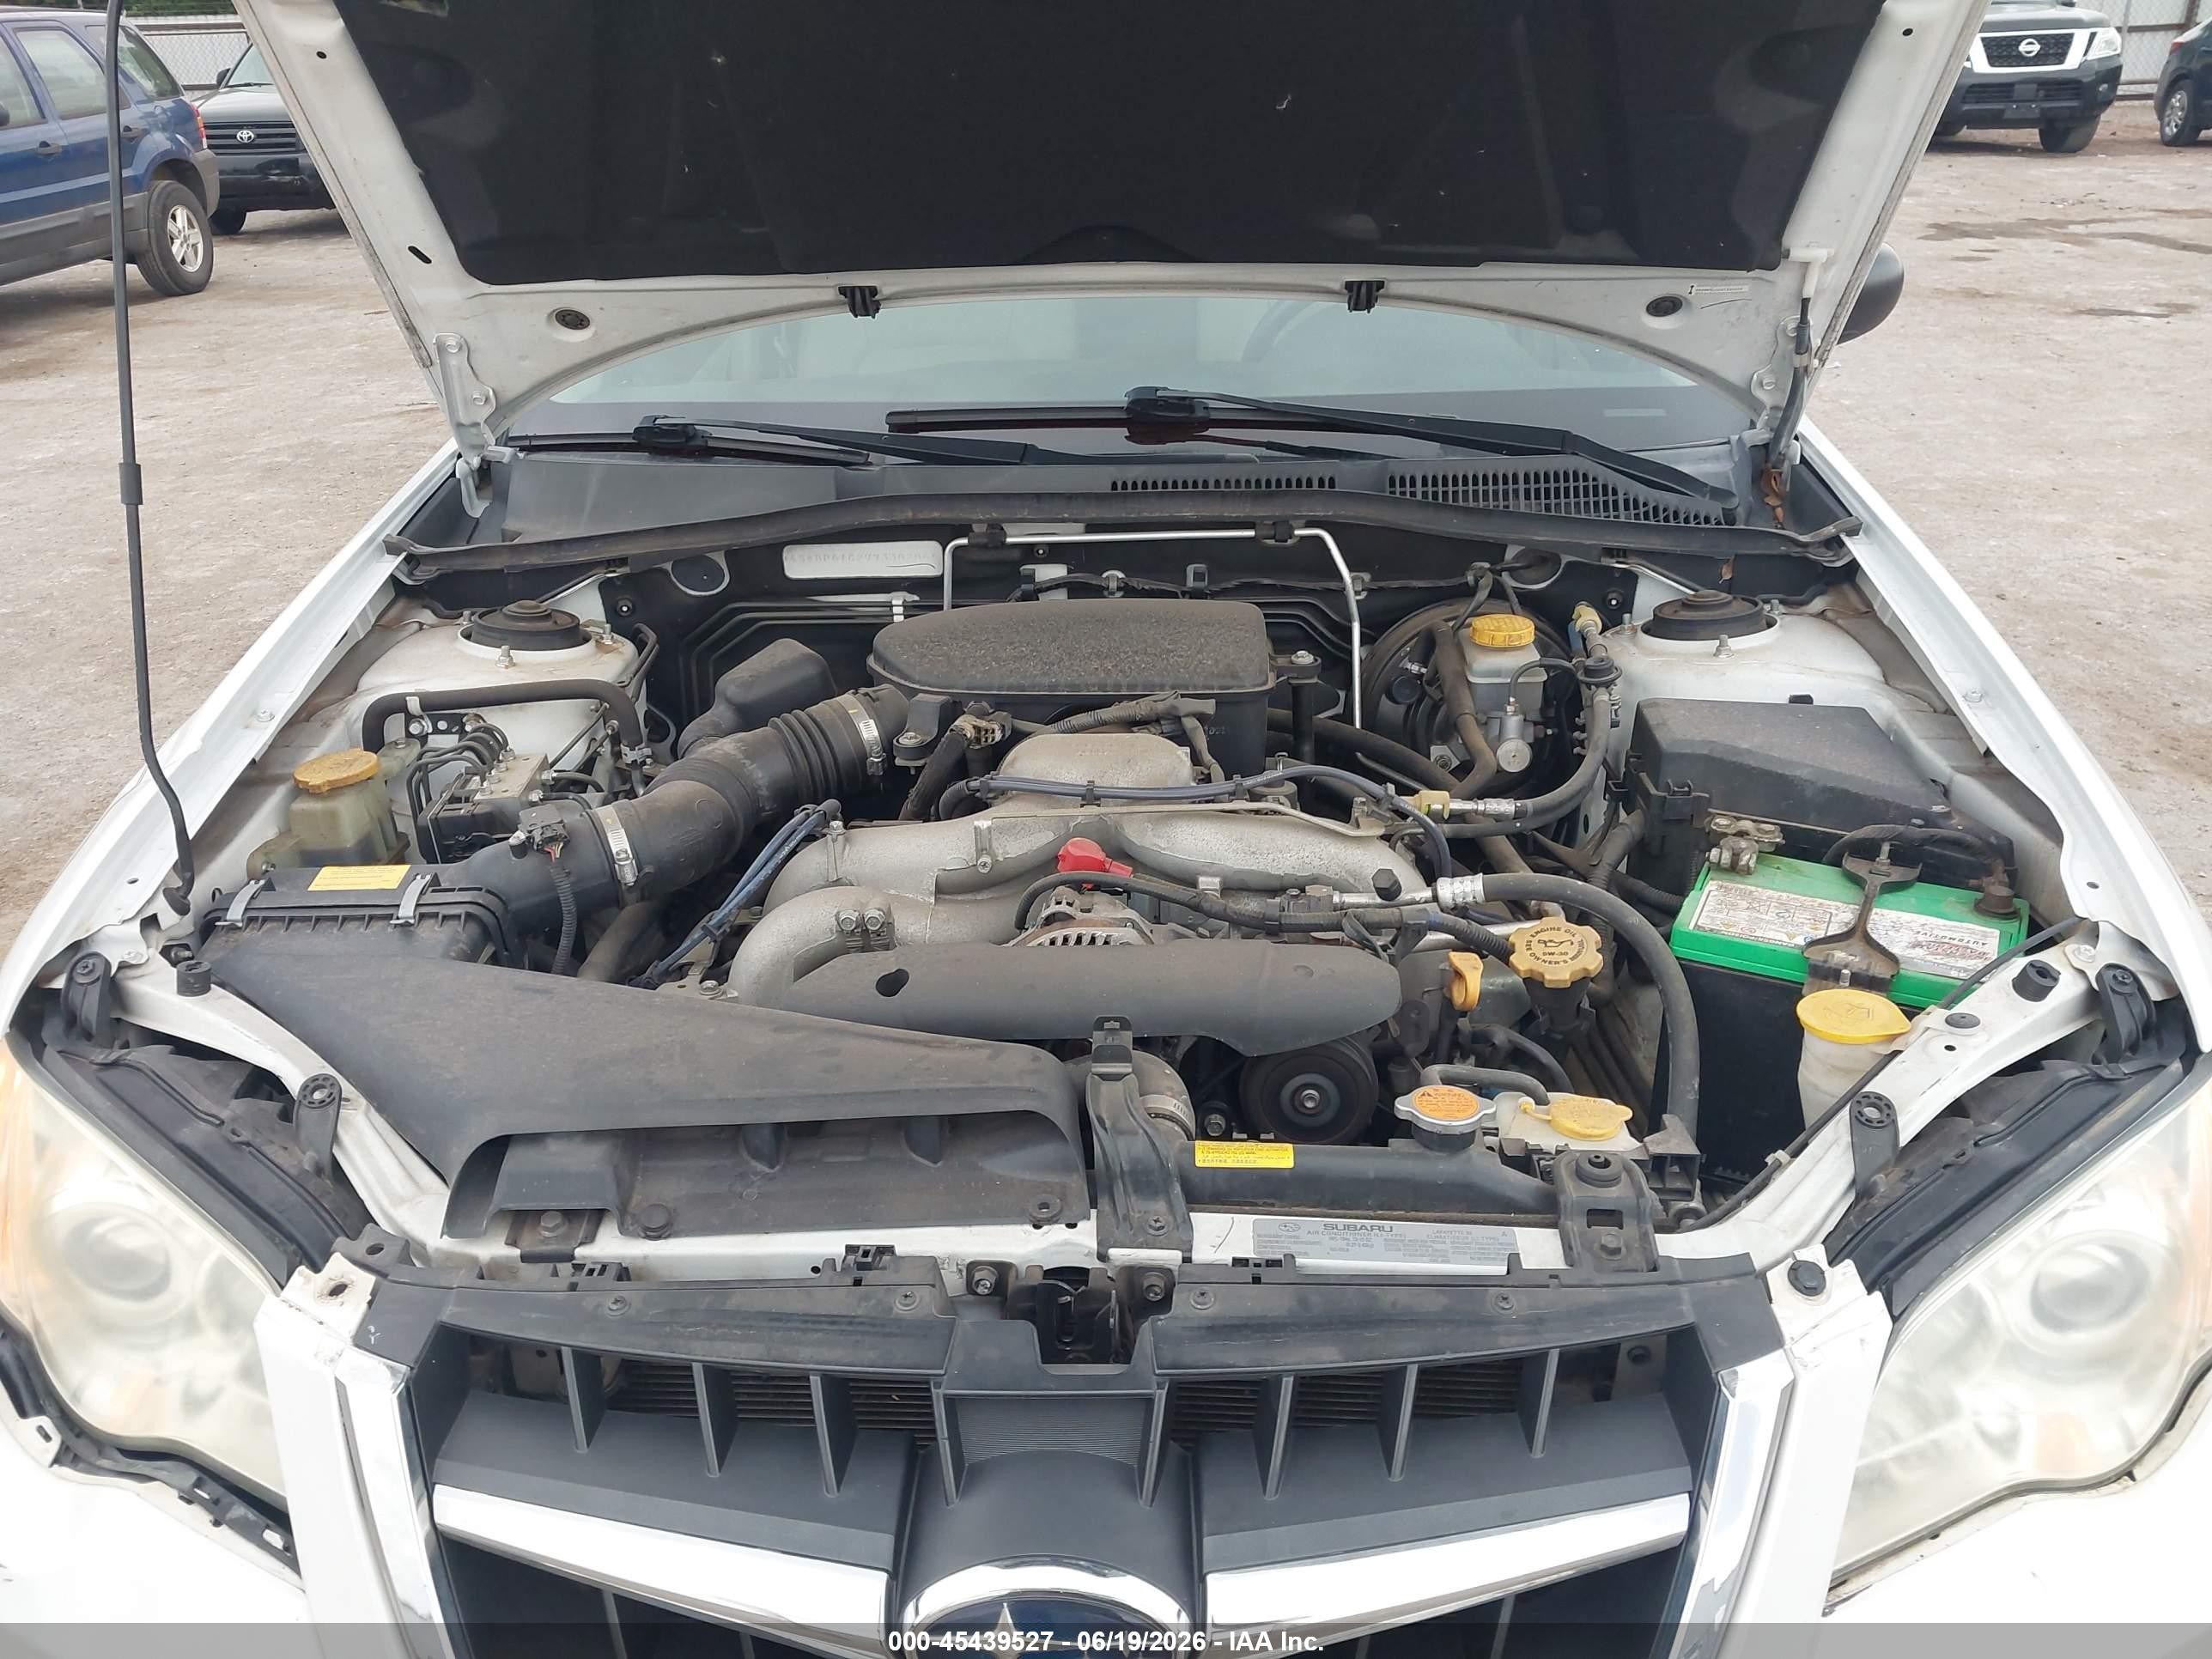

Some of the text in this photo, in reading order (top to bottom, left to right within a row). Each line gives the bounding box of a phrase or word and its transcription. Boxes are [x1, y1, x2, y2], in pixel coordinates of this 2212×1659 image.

[1529, 927, 1577, 938] ENGINE OIL
[1912, 930, 1988, 947] AUTOMOTIVE
[1529, 952, 1568, 964] OWNER'S
[1322, 1223, 1394, 1233] SUBARU
